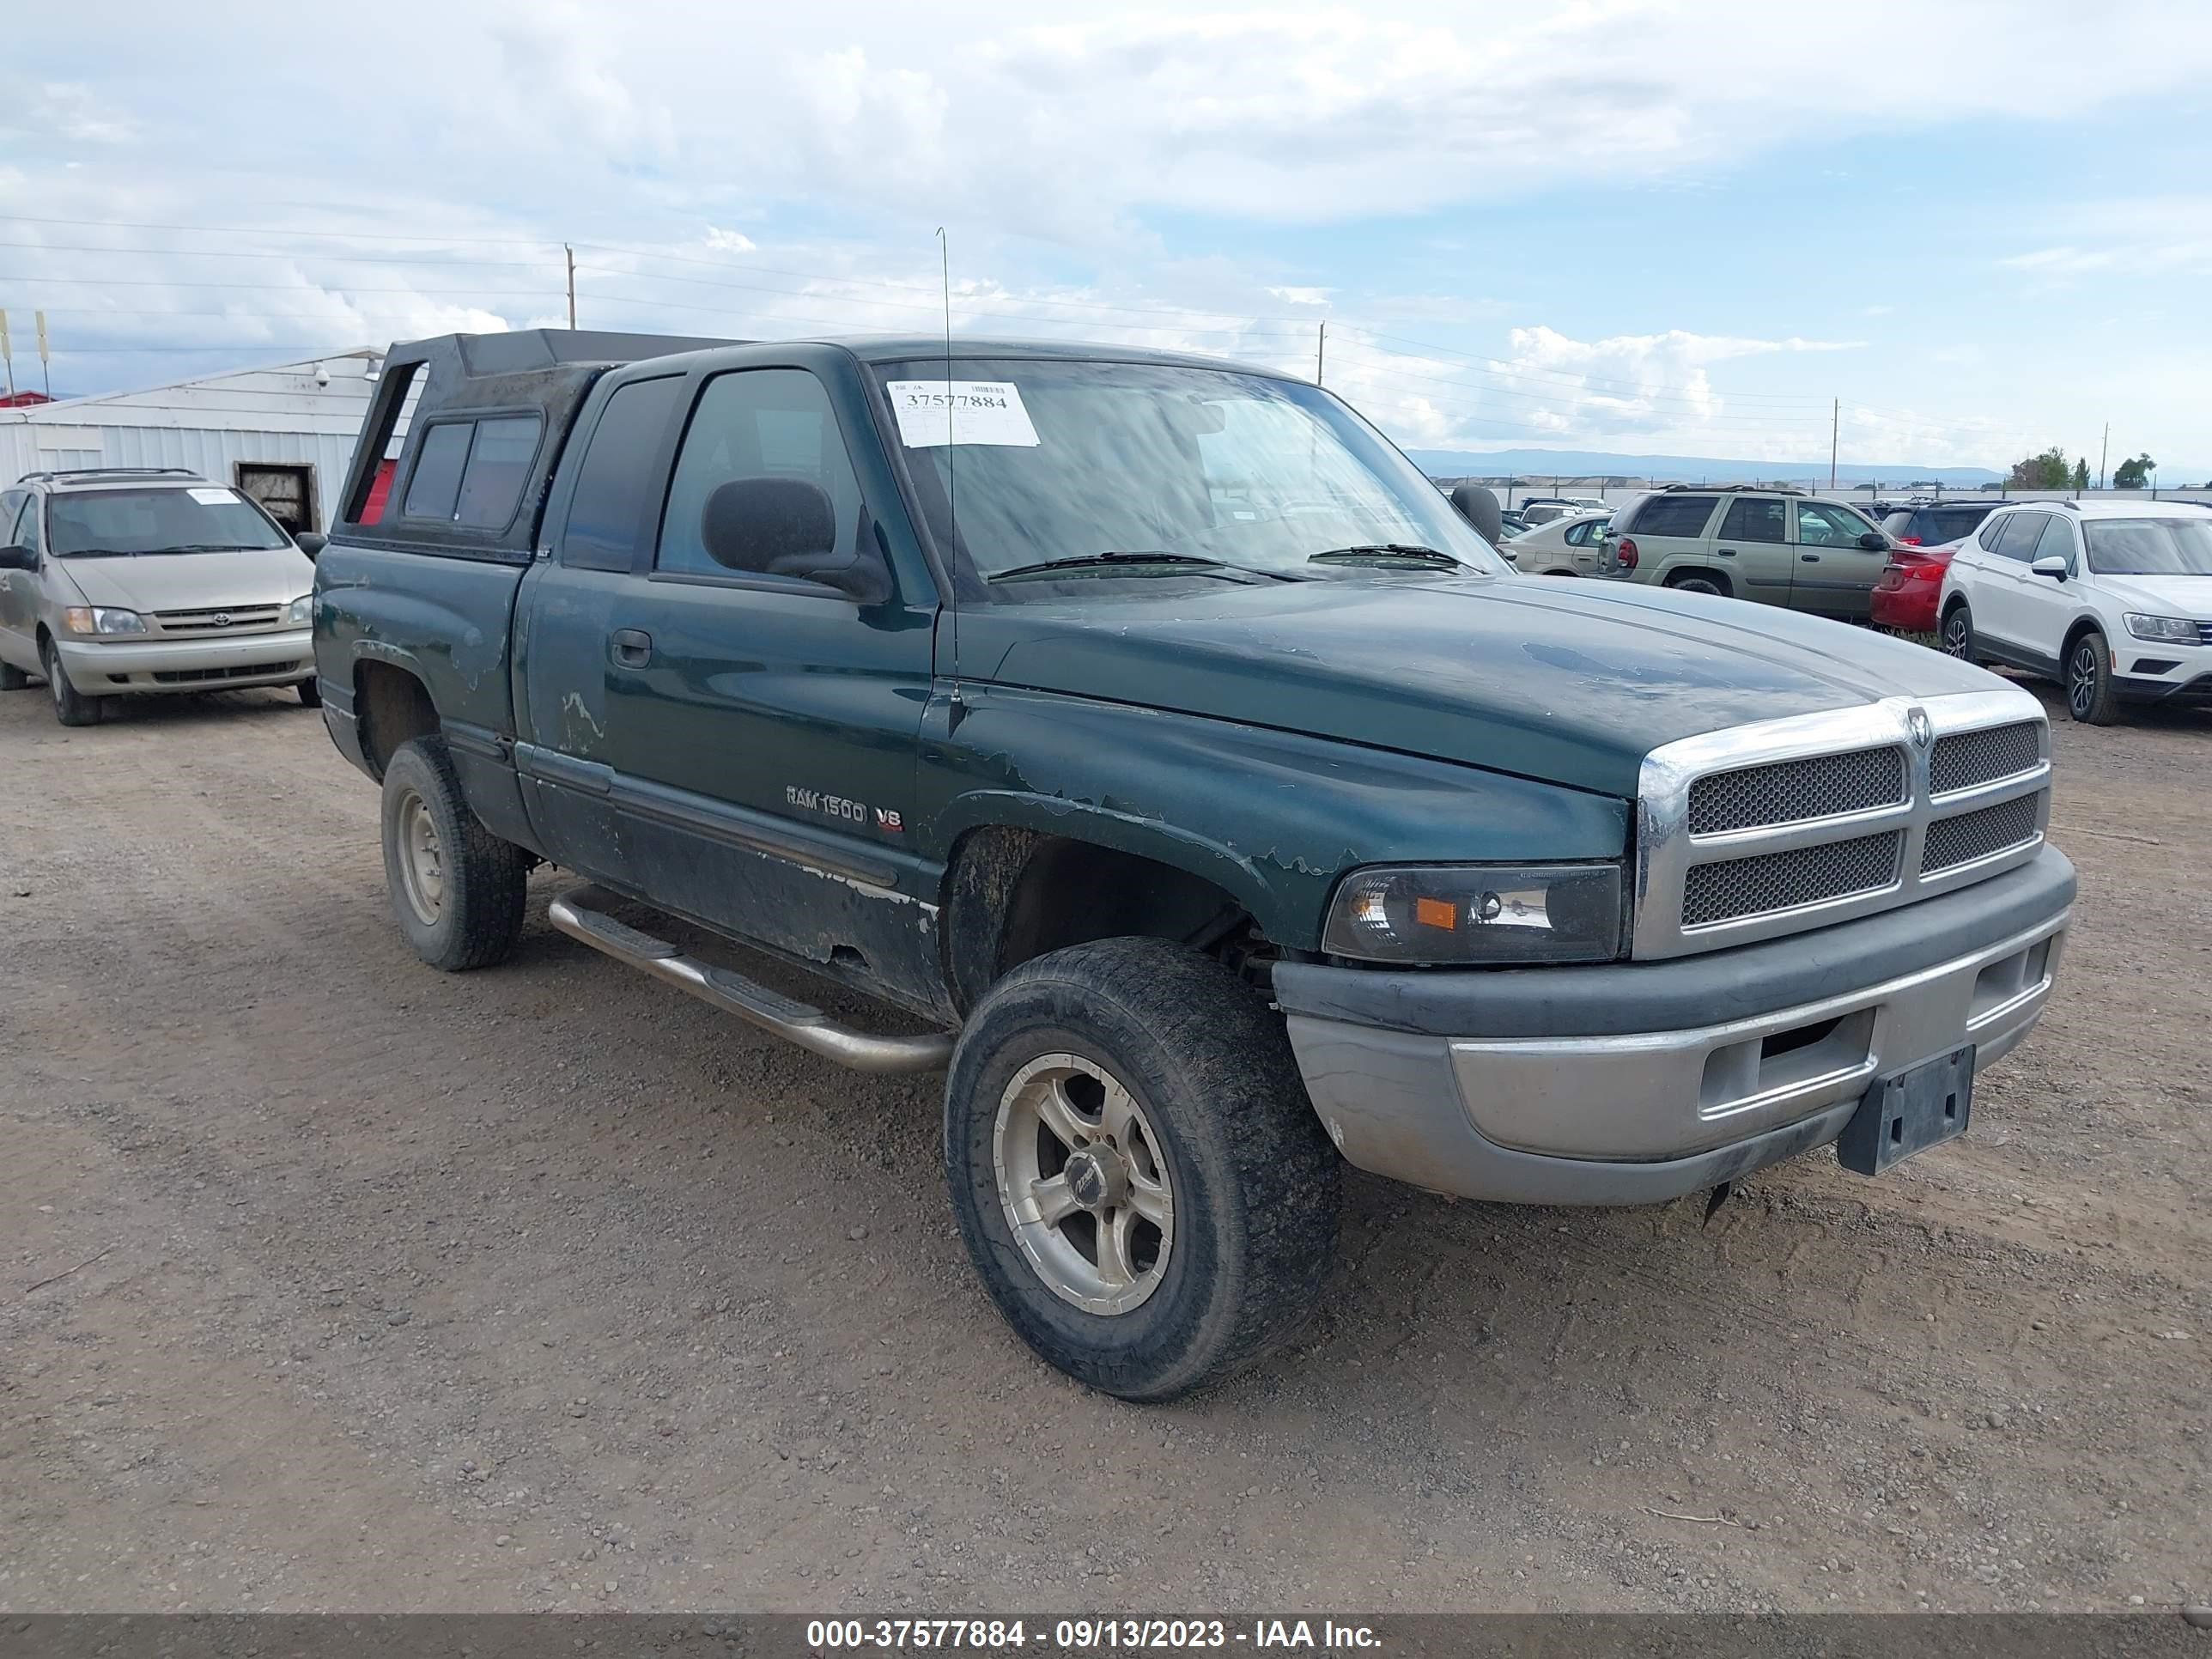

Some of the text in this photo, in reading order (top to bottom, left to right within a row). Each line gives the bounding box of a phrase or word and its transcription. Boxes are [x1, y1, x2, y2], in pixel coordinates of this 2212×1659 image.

[907, 394, 1007, 409] 37577884
[786, 785, 902, 827] RAM 1500 V8
